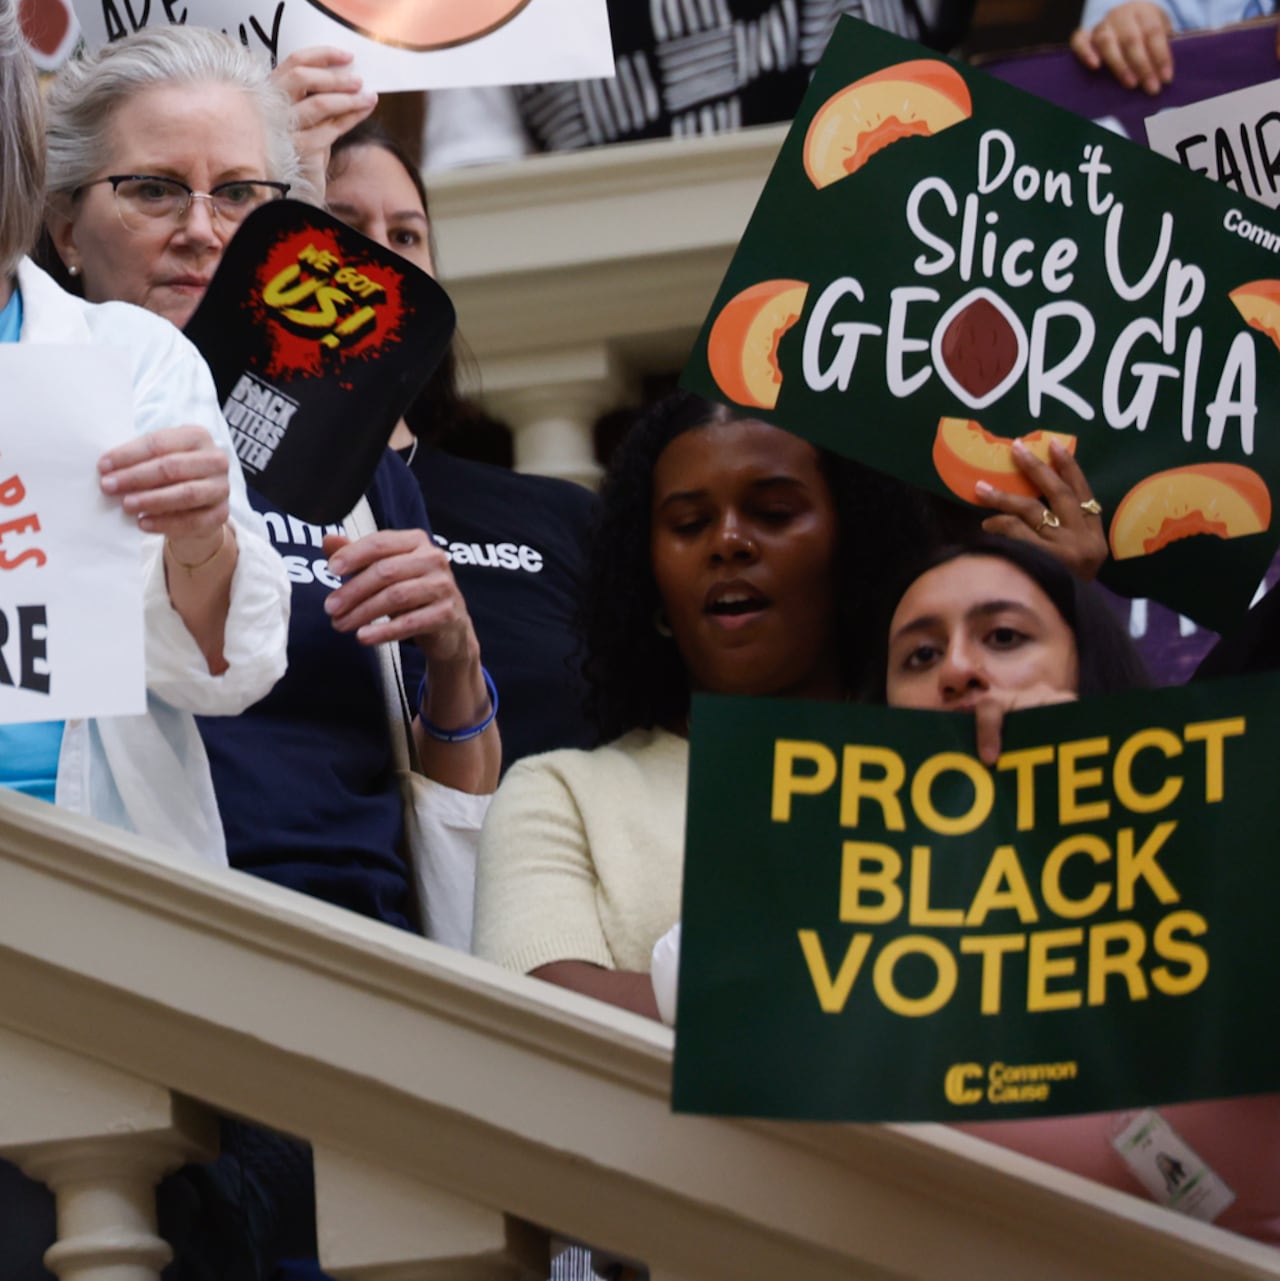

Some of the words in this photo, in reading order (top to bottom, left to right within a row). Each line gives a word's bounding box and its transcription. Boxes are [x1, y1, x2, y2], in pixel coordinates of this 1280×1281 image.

[977, 129, 1114, 216] Don't
[297, 243, 340, 274] WE
[334, 266, 386, 299] GOT
[906, 176, 1078, 293] Slice
[1104, 202, 1206, 355] Up
[1223, 208, 1280, 253] Comm
[263, 264, 376, 349] US!
[802, 276, 1258, 455] GEORGIA
[771, 716, 1246, 835] PROTECT
[839, 821, 1180, 927] BLACK
[797, 911, 1209, 1017] VOTERS
[988, 1061, 1077, 1083] Common
